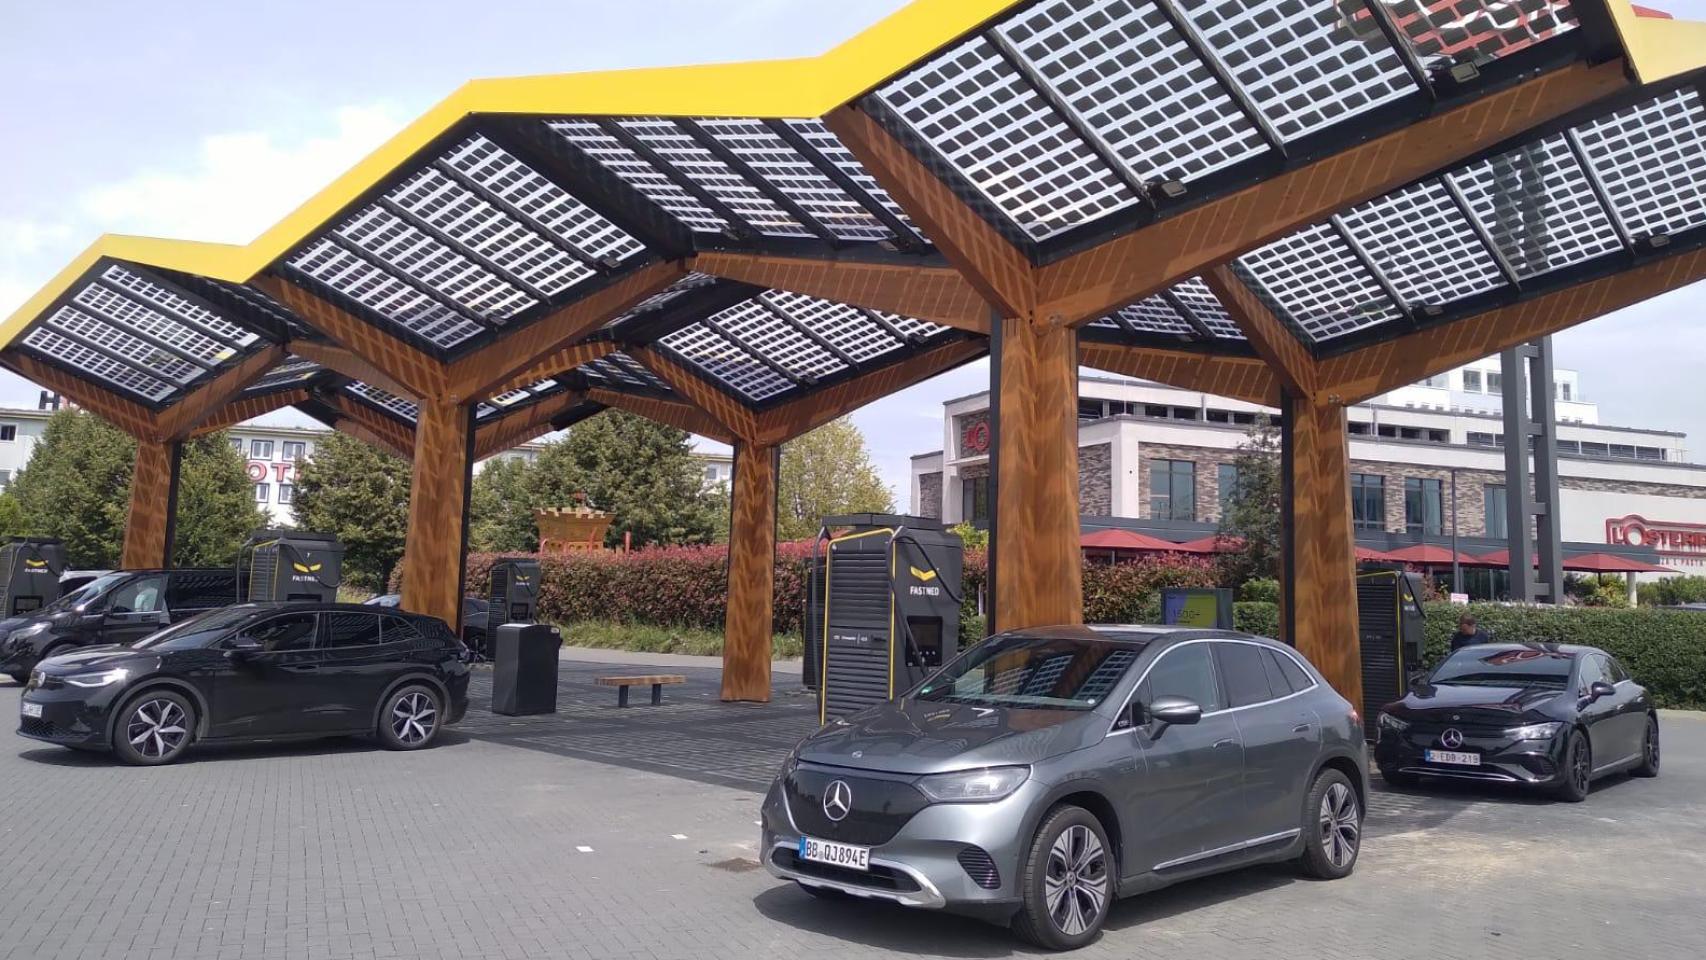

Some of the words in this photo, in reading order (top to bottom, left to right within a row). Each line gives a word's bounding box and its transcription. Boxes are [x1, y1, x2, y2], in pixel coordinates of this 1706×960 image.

[910, 586, 939, 596] FASTNED
[806, 840, 818, 858] BB
[824, 844, 867, 867] QJ894E
